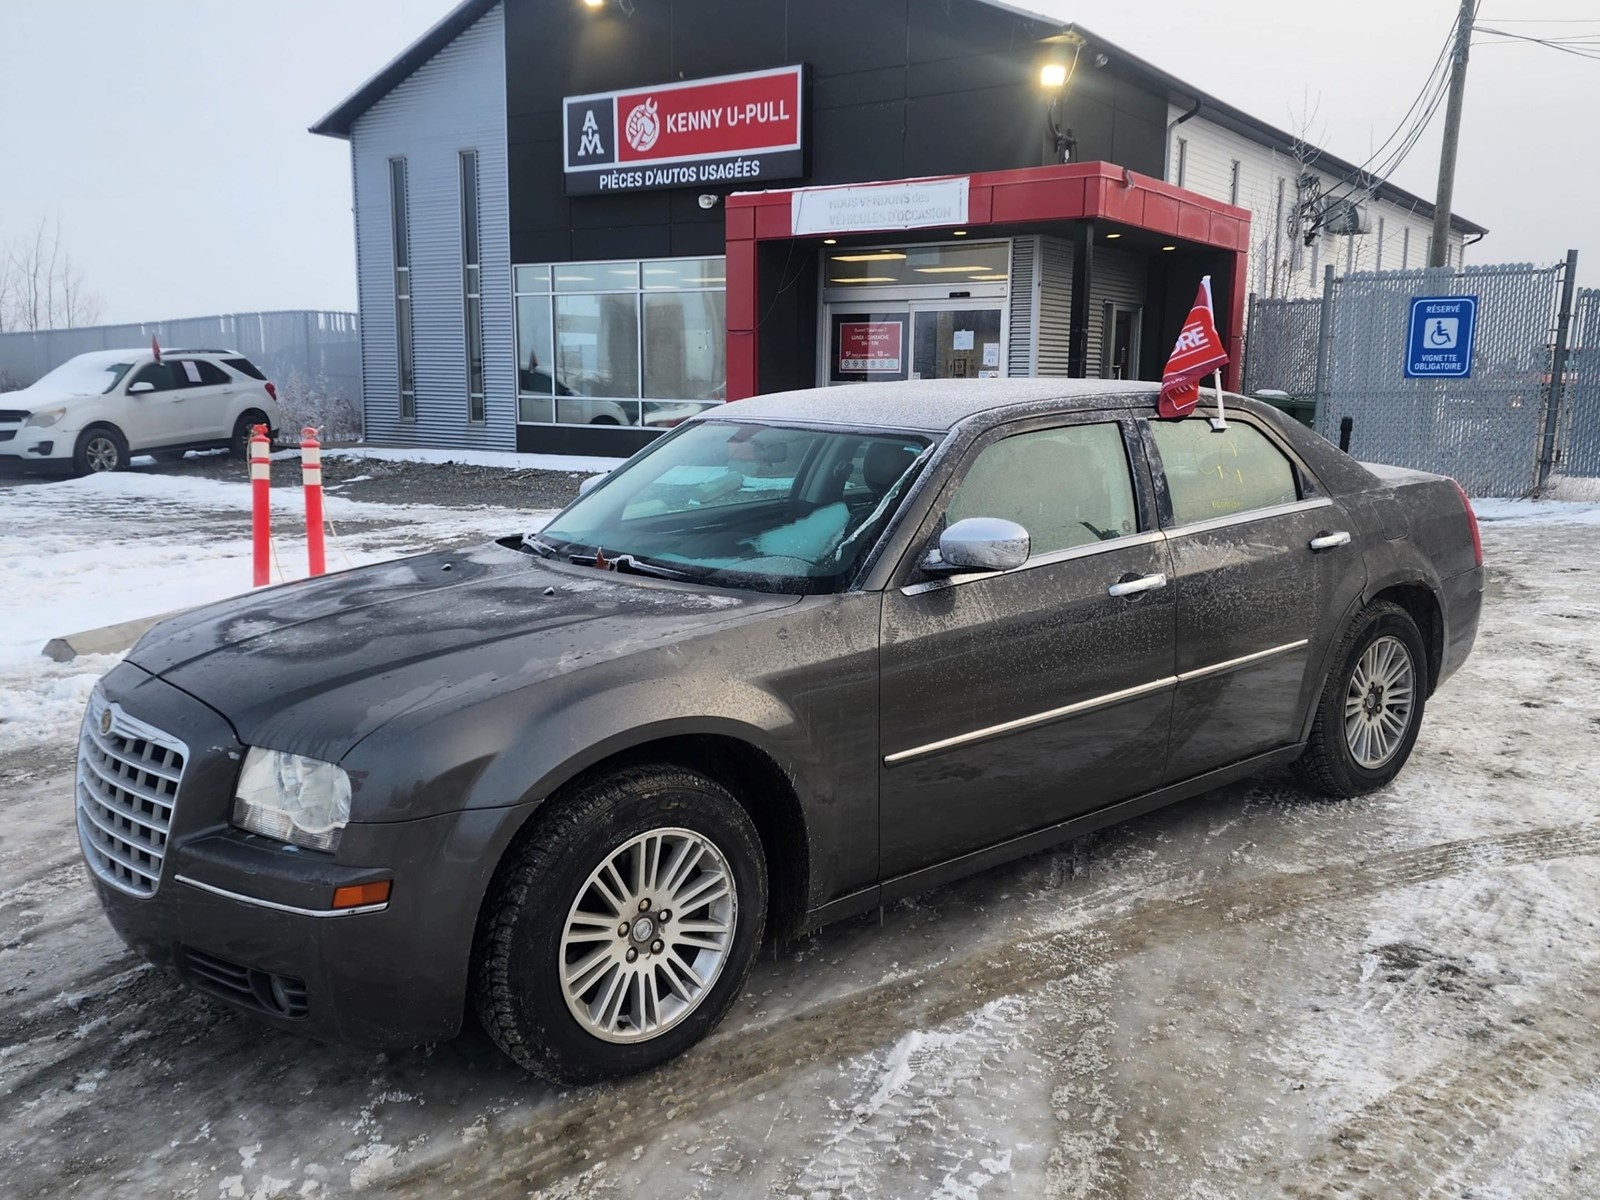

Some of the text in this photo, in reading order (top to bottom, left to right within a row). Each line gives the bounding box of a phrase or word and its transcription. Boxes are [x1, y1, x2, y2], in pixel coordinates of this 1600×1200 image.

[666, 99, 790, 134] KENNY U-PULL
[599, 158, 760, 190] PIÈCES D'AUTOS USAGÉES
[1426, 303, 1461, 314] RÉSERVÉ
[1421, 354, 1458, 362] VIGNETTE
[1414, 362, 1462, 371] OBLIGATOIRE
